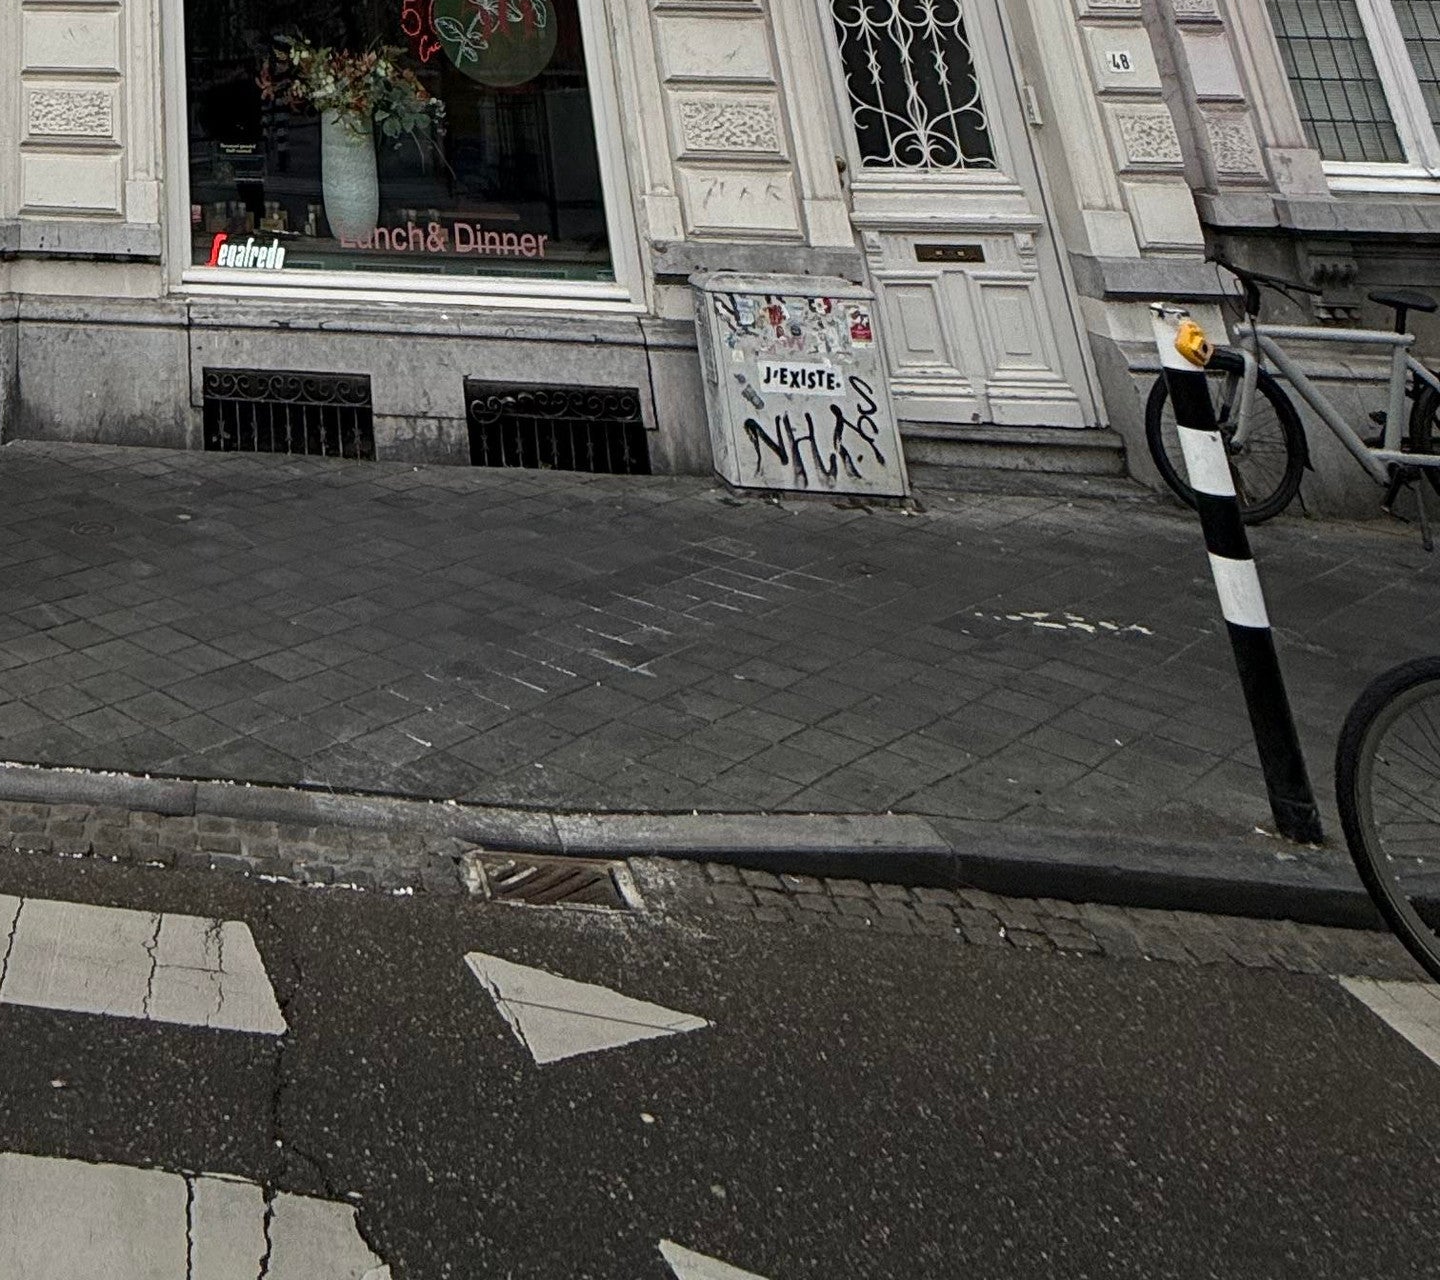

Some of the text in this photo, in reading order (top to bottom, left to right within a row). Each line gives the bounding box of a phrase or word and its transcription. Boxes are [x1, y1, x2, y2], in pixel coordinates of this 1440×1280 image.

[1112, 54, 1130, 70] 48
[206, 233, 286, 269] Segafredo
[453, 222, 548, 259] Dinner
[763, 366, 841, 390] J'EXISTE.
